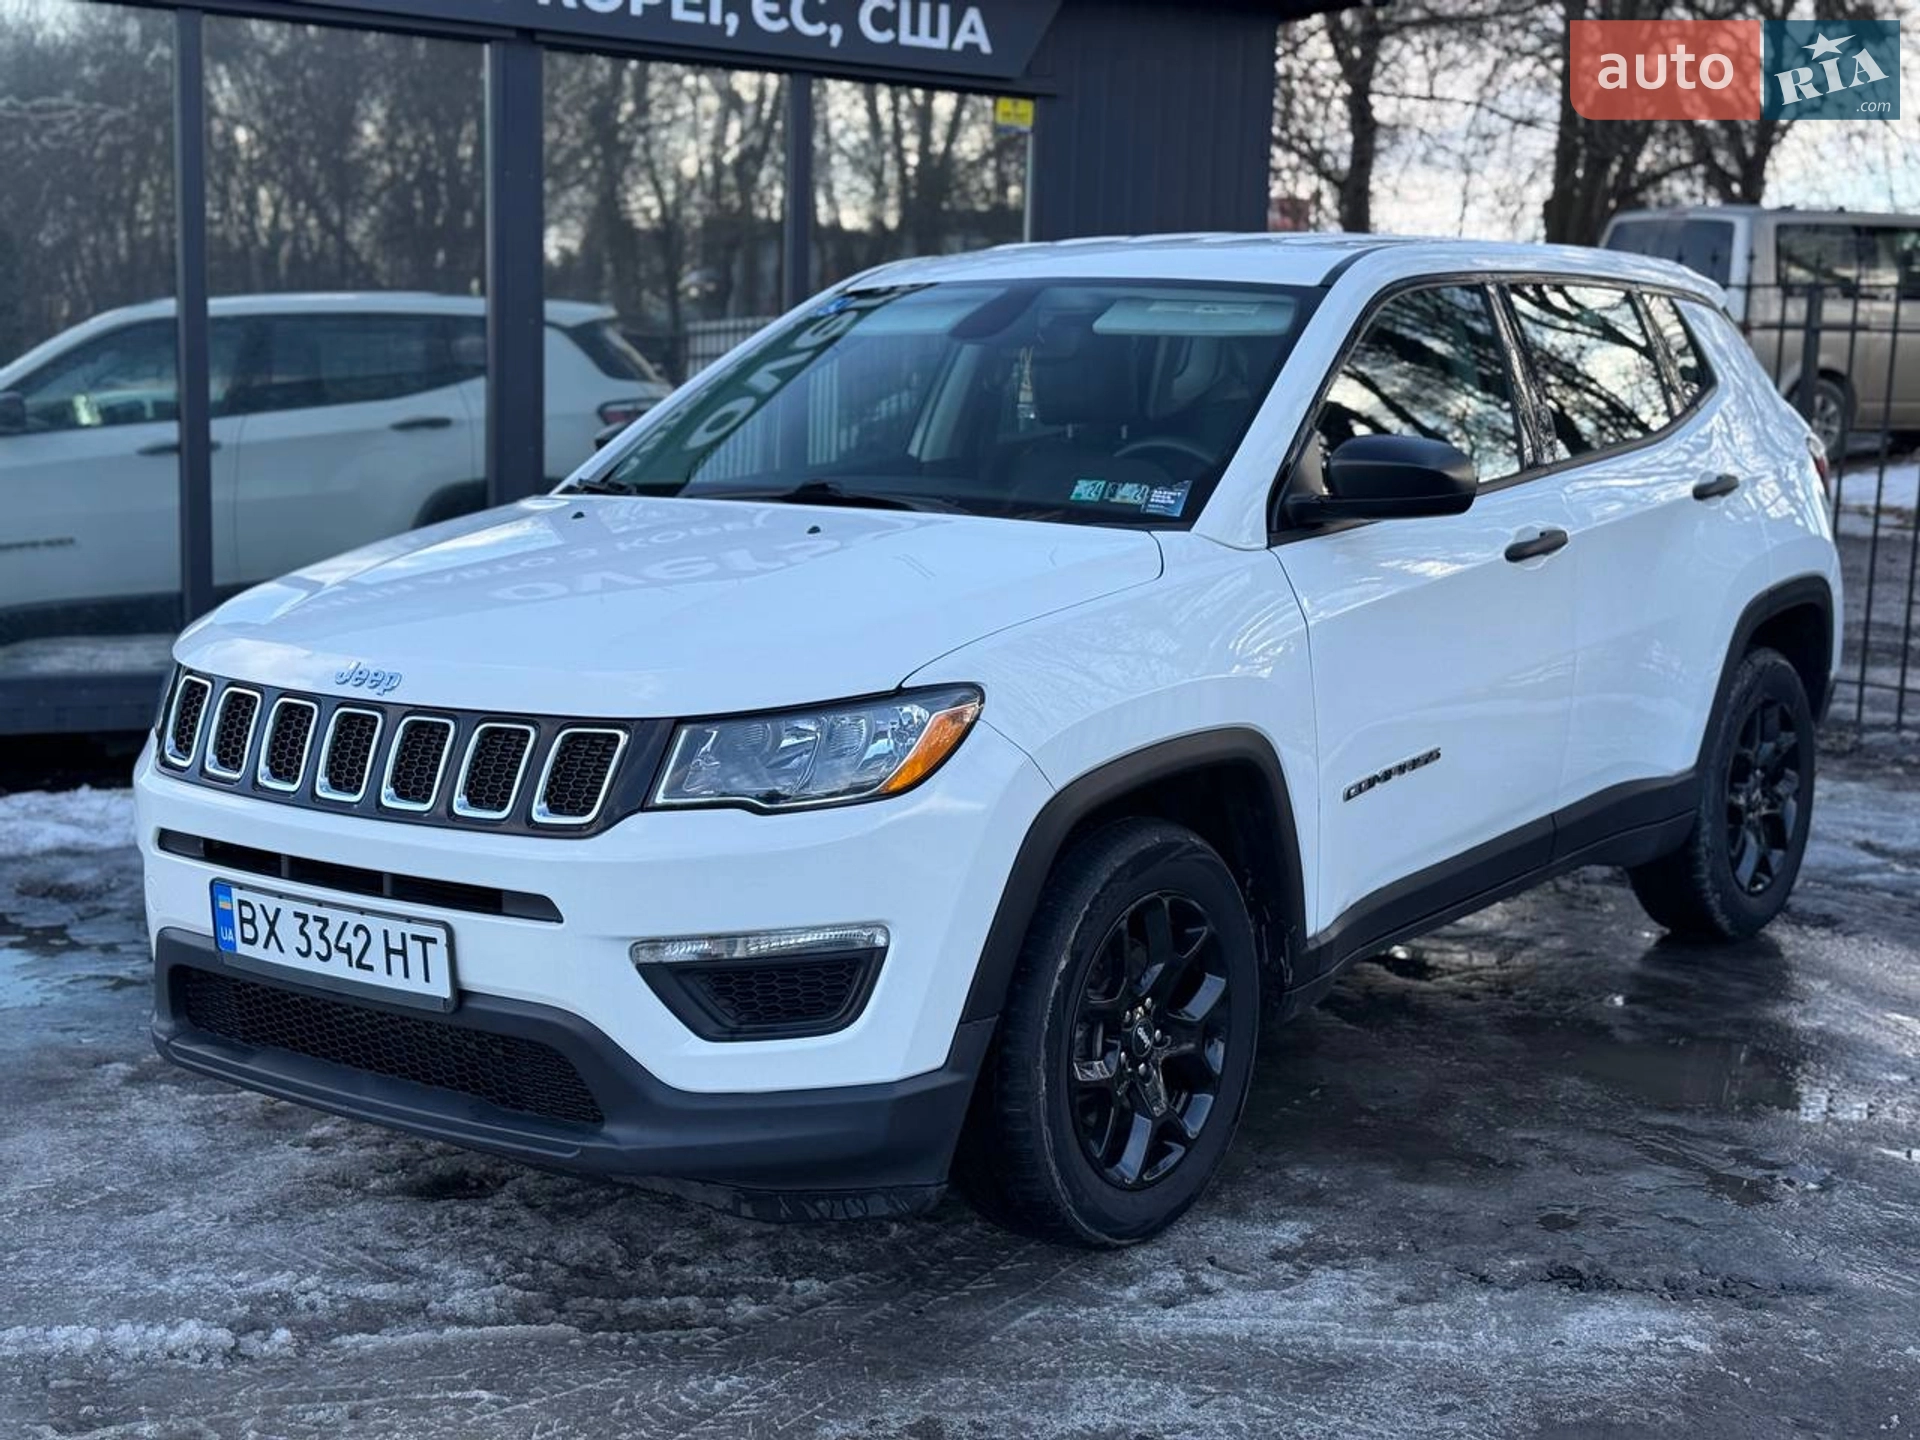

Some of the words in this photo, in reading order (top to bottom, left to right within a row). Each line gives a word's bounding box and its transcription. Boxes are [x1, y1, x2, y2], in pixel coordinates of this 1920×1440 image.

[858, 0, 992, 54] США
[335, 661, 402, 697] Jeep
[220, 928, 234, 942] UA
[237, 898, 285, 953] BX
[293, 911, 374, 972] 3342
[383, 929, 437, 983] HT
